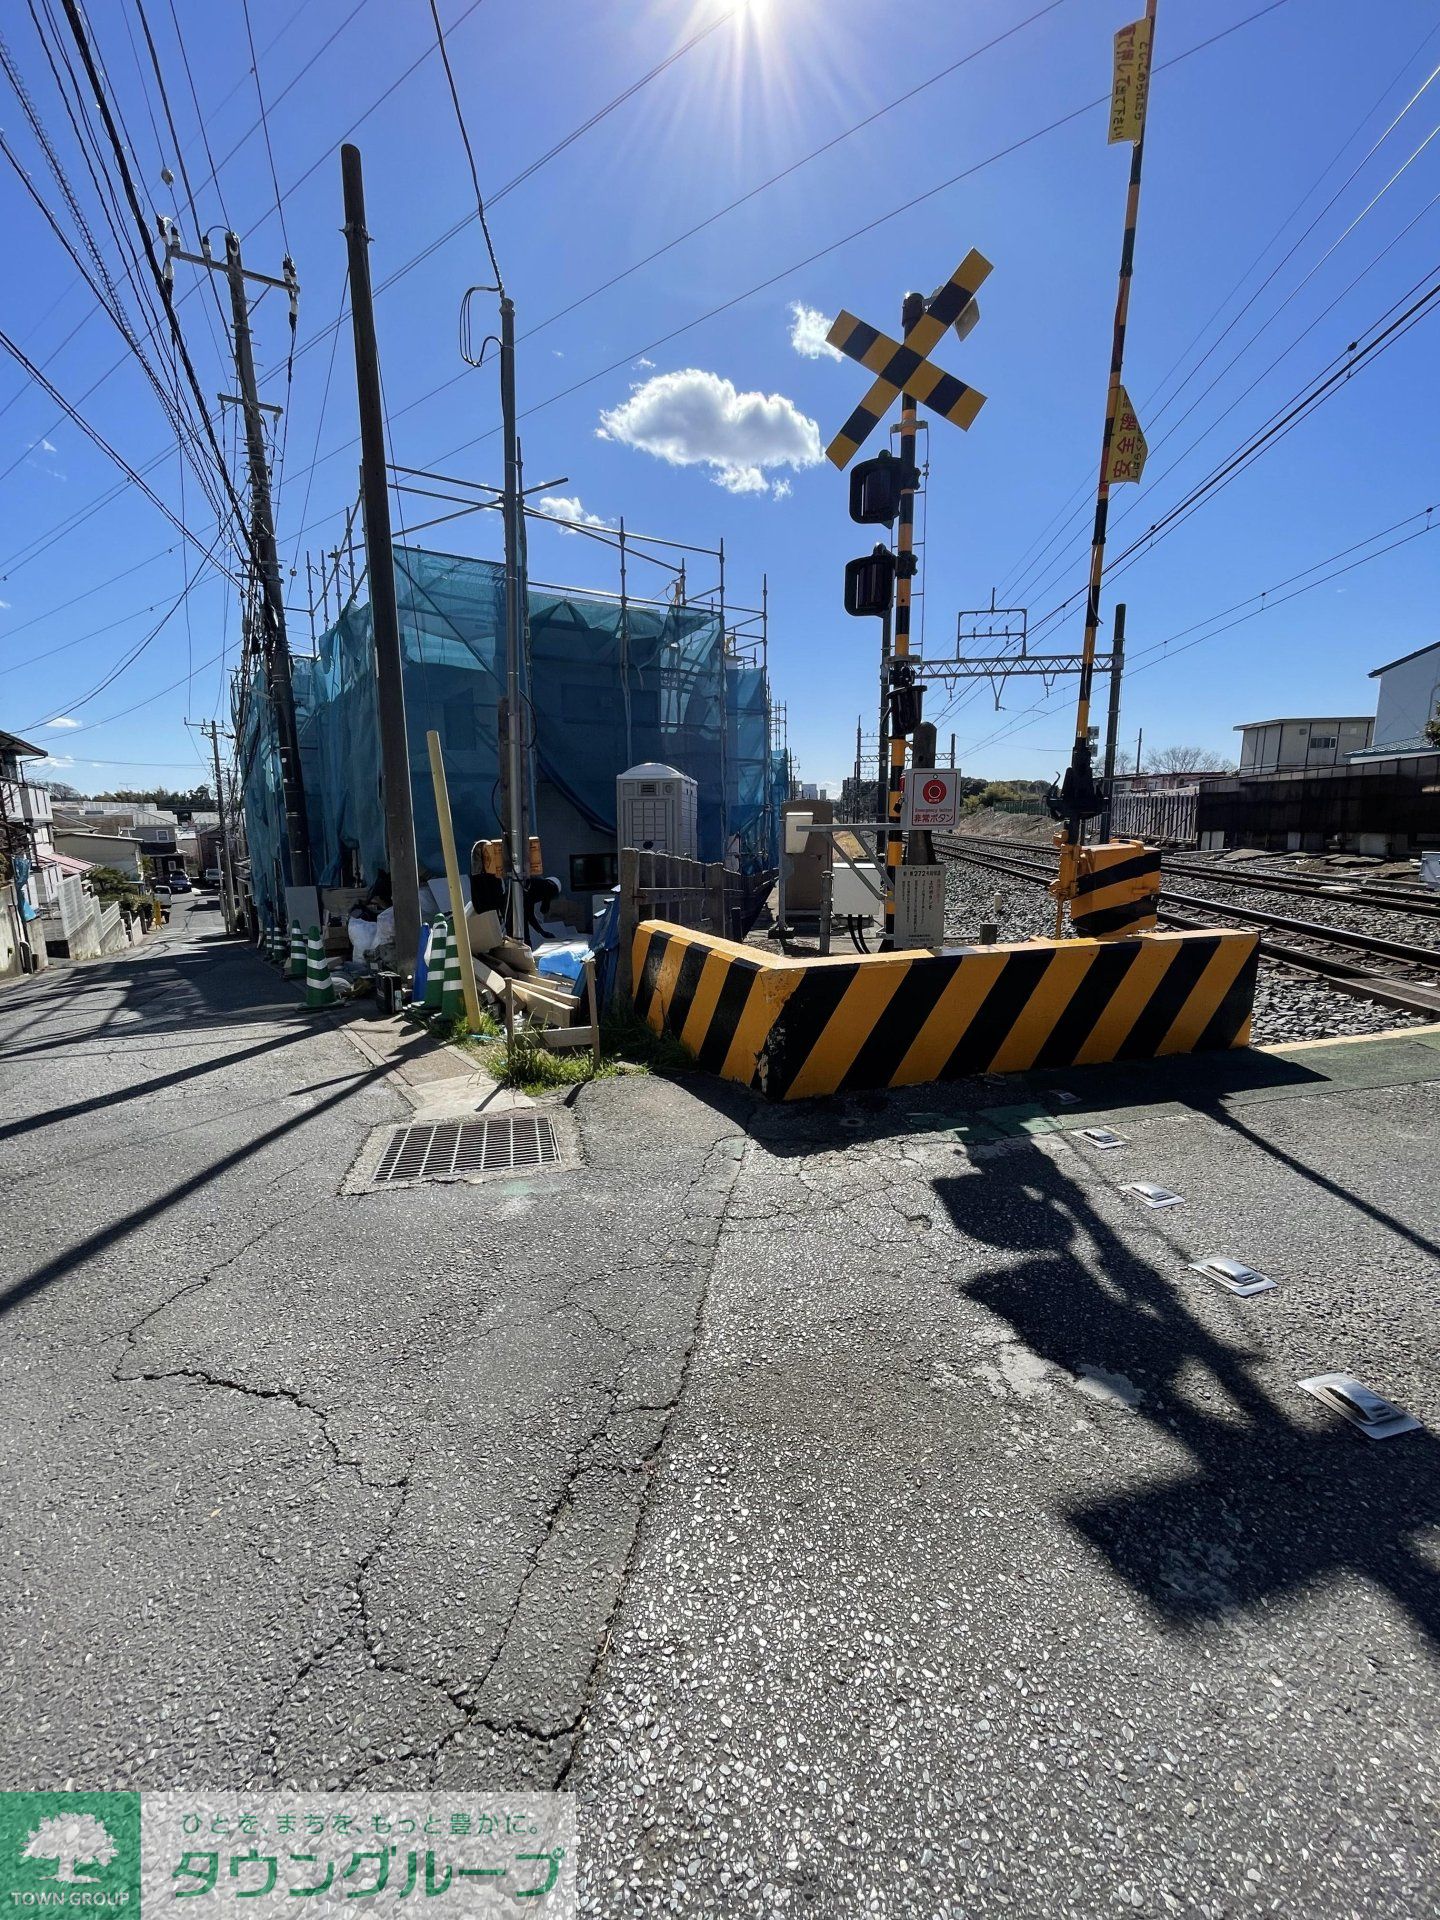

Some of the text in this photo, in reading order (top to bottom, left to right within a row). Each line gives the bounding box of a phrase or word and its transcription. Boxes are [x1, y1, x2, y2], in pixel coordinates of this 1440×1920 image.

[914, 813, 953, 823] 非常ボタン
